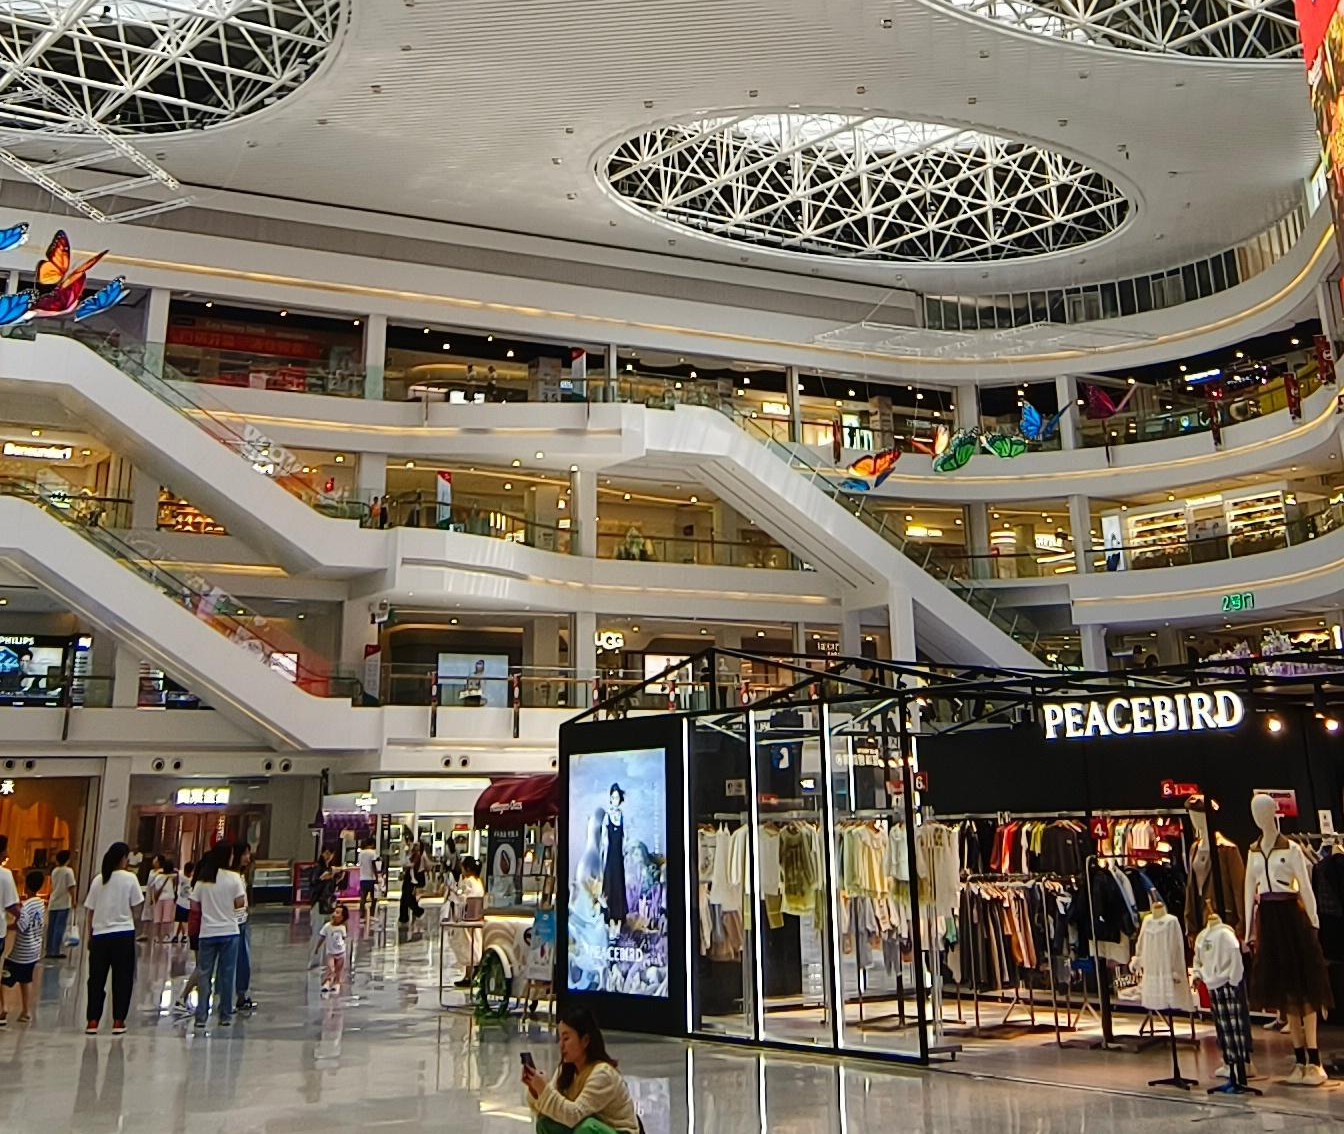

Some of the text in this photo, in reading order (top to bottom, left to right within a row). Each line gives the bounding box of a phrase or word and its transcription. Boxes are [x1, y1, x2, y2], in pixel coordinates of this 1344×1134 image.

[0, 635, 35, 646] PHILIPS
[594, 631, 624, 650] UGG
[1042, 690, 1246, 740] PEACEBIRD
